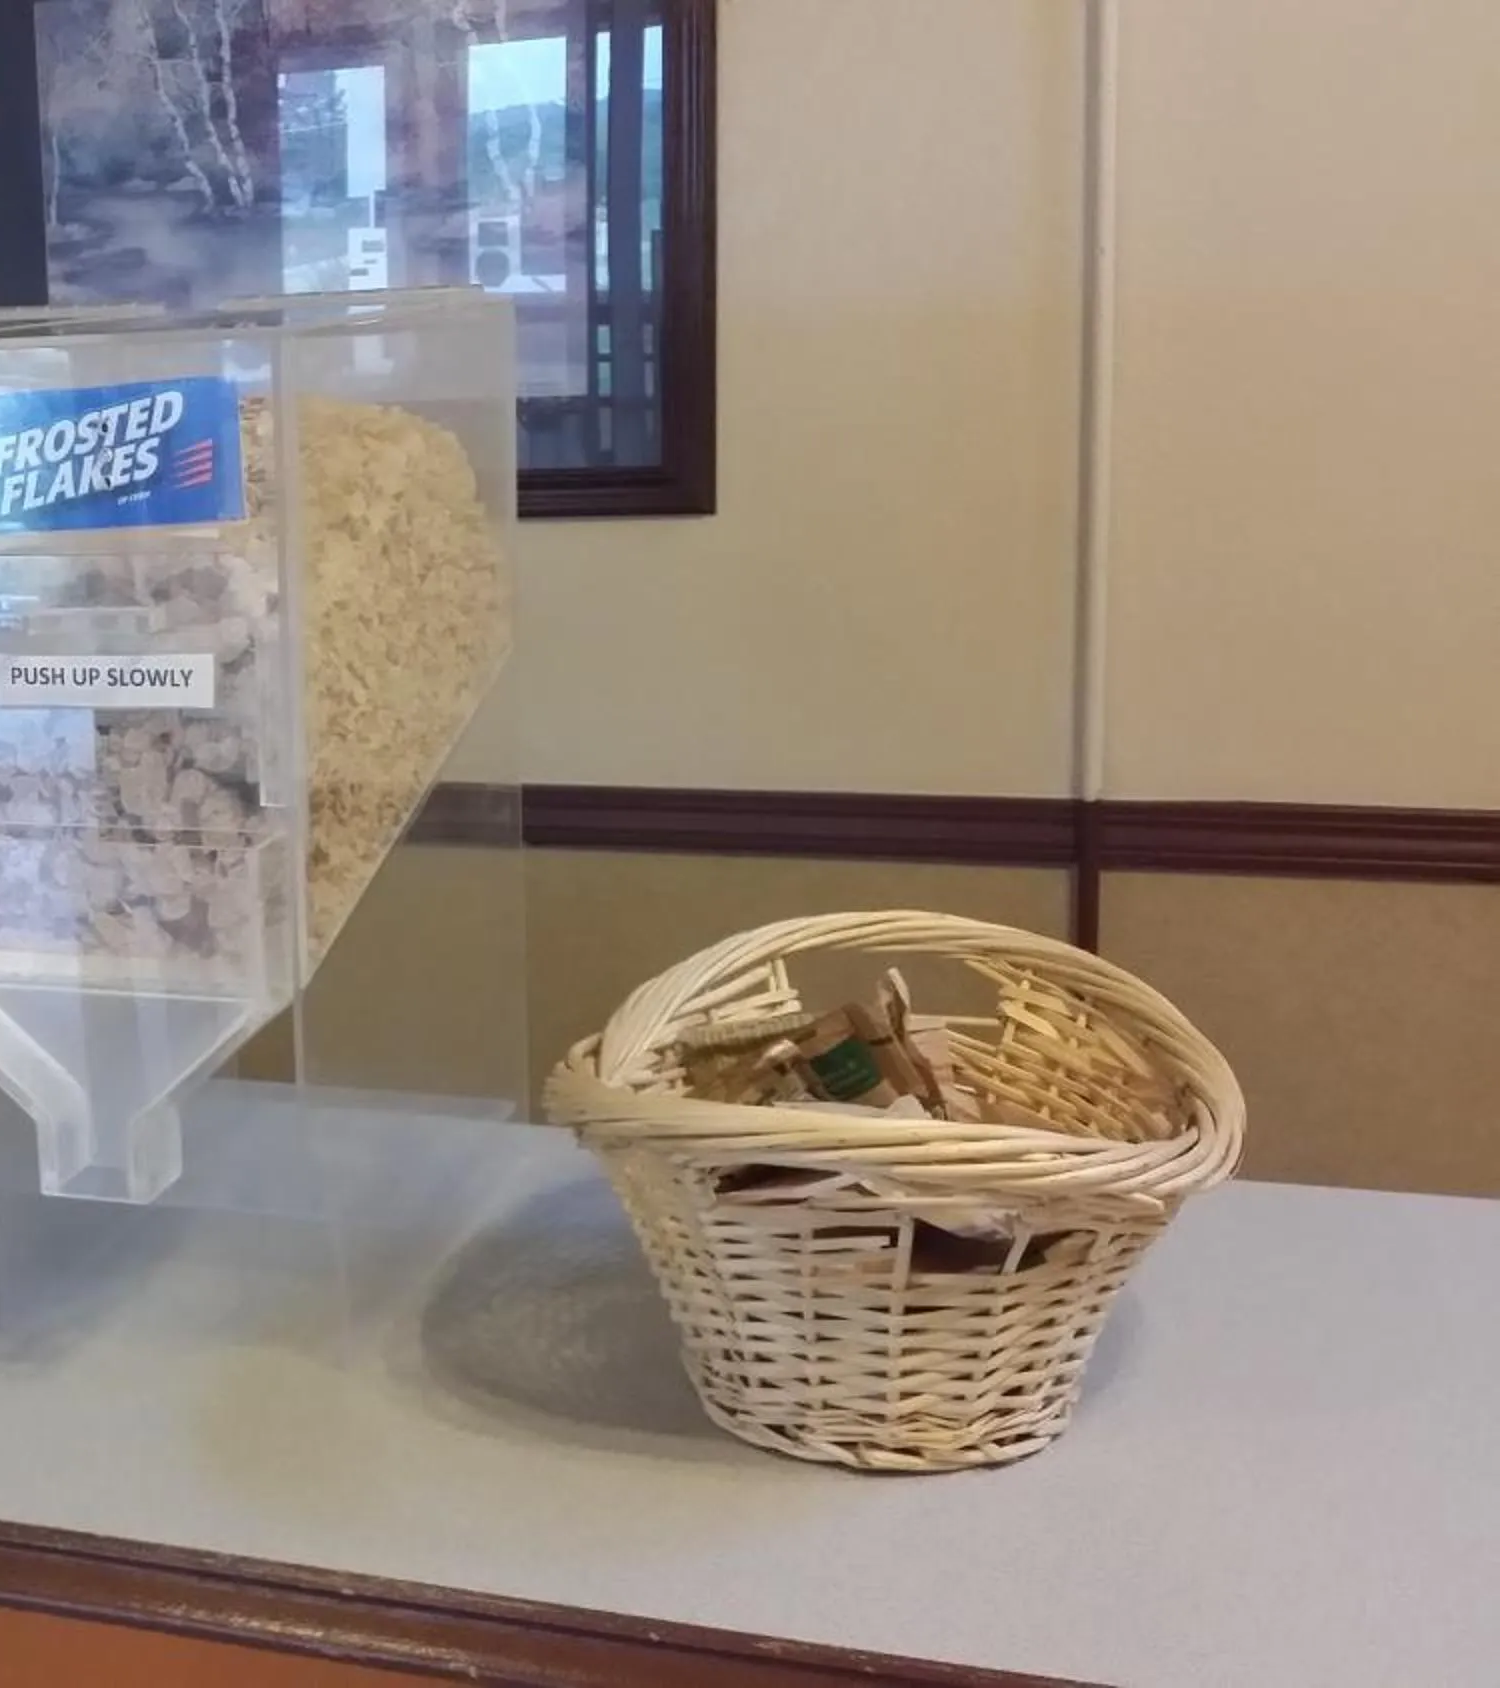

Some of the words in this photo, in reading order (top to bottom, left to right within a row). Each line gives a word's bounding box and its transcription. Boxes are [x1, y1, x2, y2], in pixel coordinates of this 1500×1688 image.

[0, 437, 160, 516] FLAKES
[10, 667, 65, 686] PUSH
[72, 667, 100, 686] UP
[107, 668, 194, 688] SLOWLY
